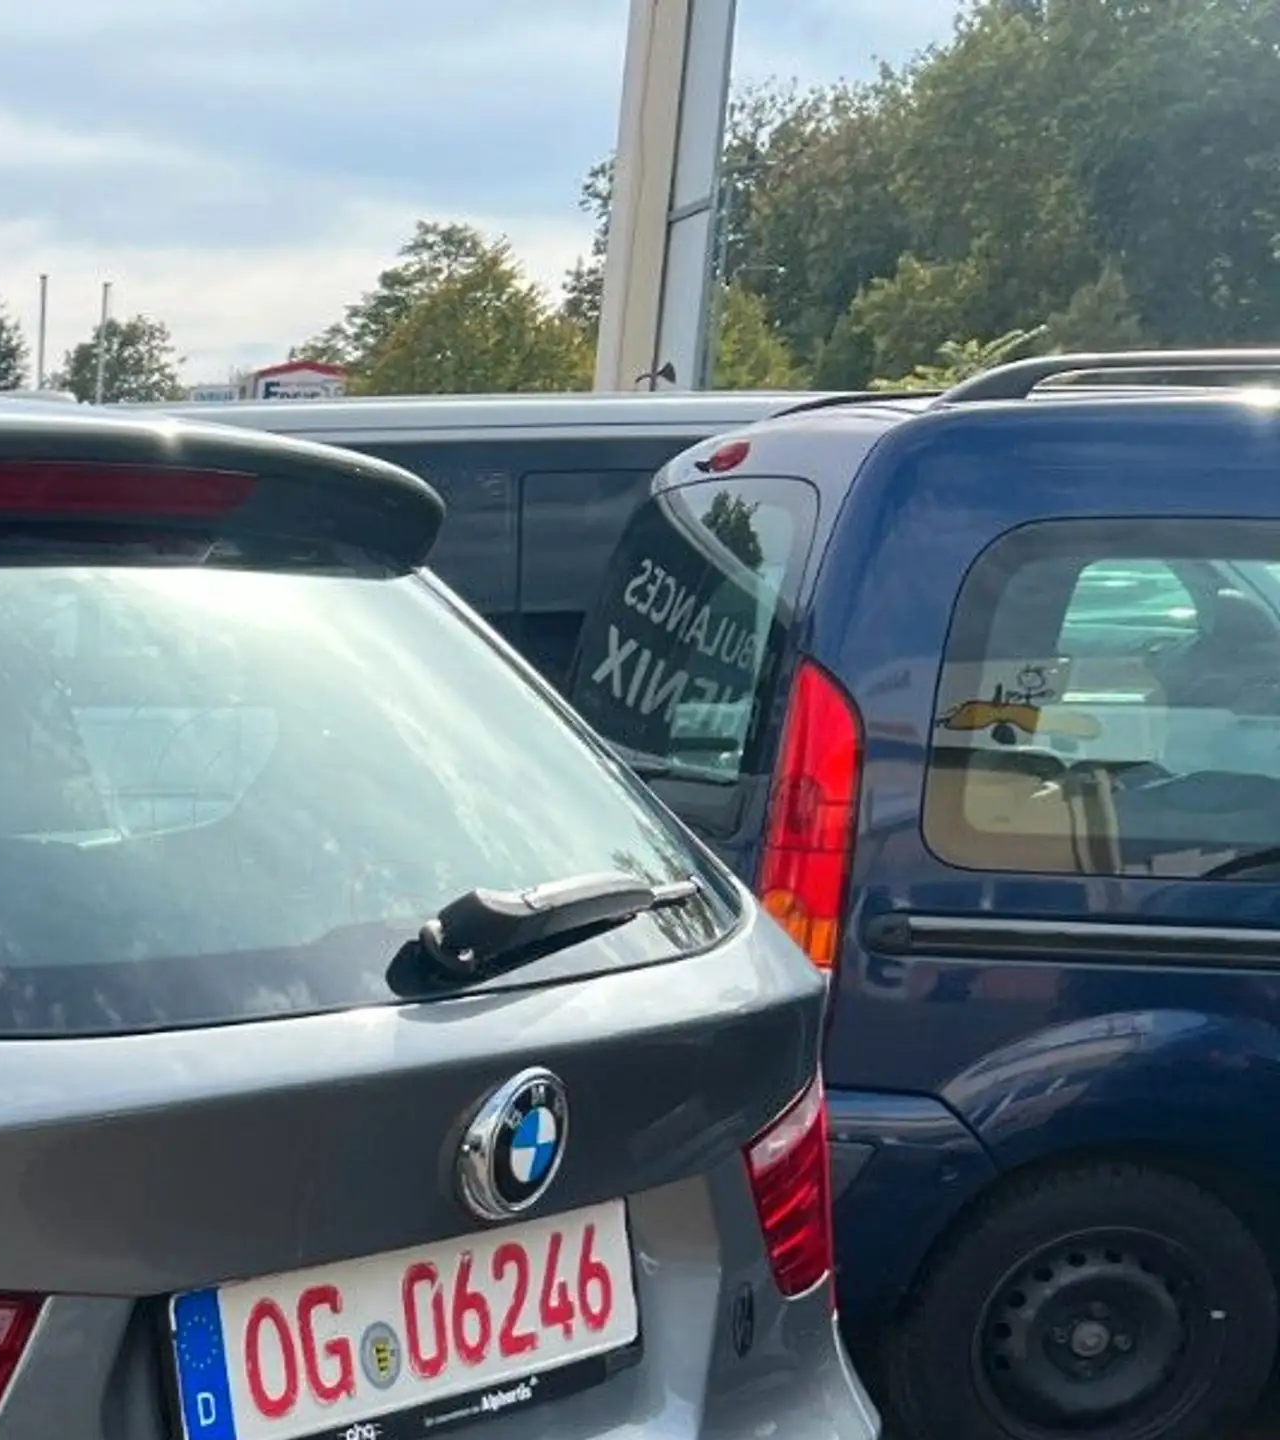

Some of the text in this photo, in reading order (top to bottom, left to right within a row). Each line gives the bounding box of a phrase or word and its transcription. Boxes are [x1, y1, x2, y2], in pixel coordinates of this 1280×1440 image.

[244, 1223, 613, 1420] OG 06246
[197, 1391, 216, 1427] D
